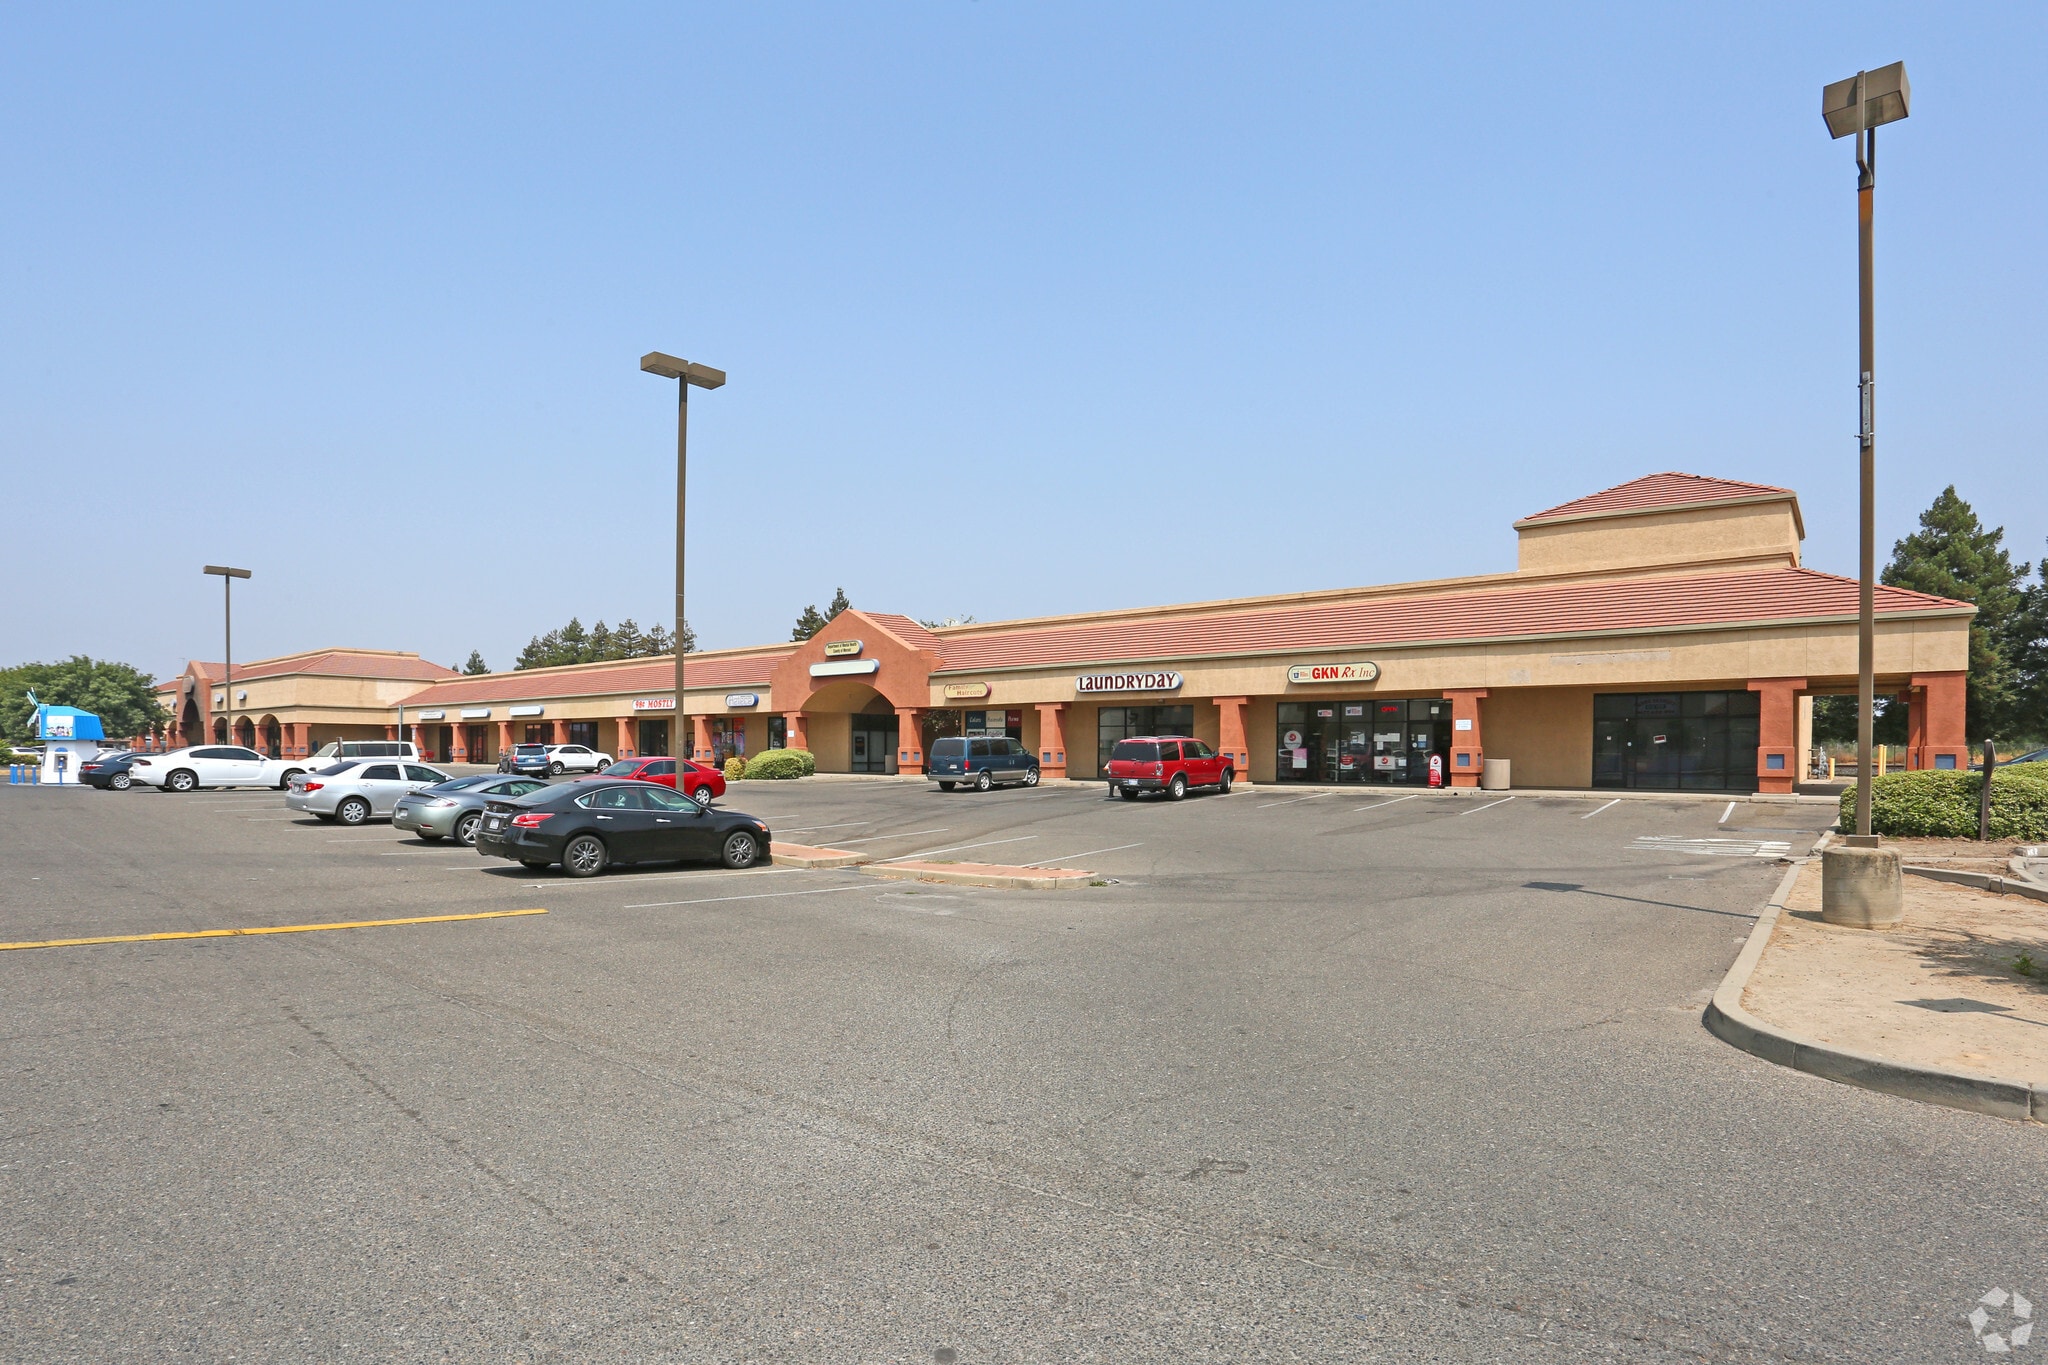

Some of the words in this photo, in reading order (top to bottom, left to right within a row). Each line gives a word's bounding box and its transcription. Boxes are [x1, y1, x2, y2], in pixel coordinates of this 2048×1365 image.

[1312, 666, 1339, 679] GKN
[1341, 666, 1357, 678] Rx
[1358, 667, 1375, 678] Inc
[647, 699, 674, 709] MOSTLY
